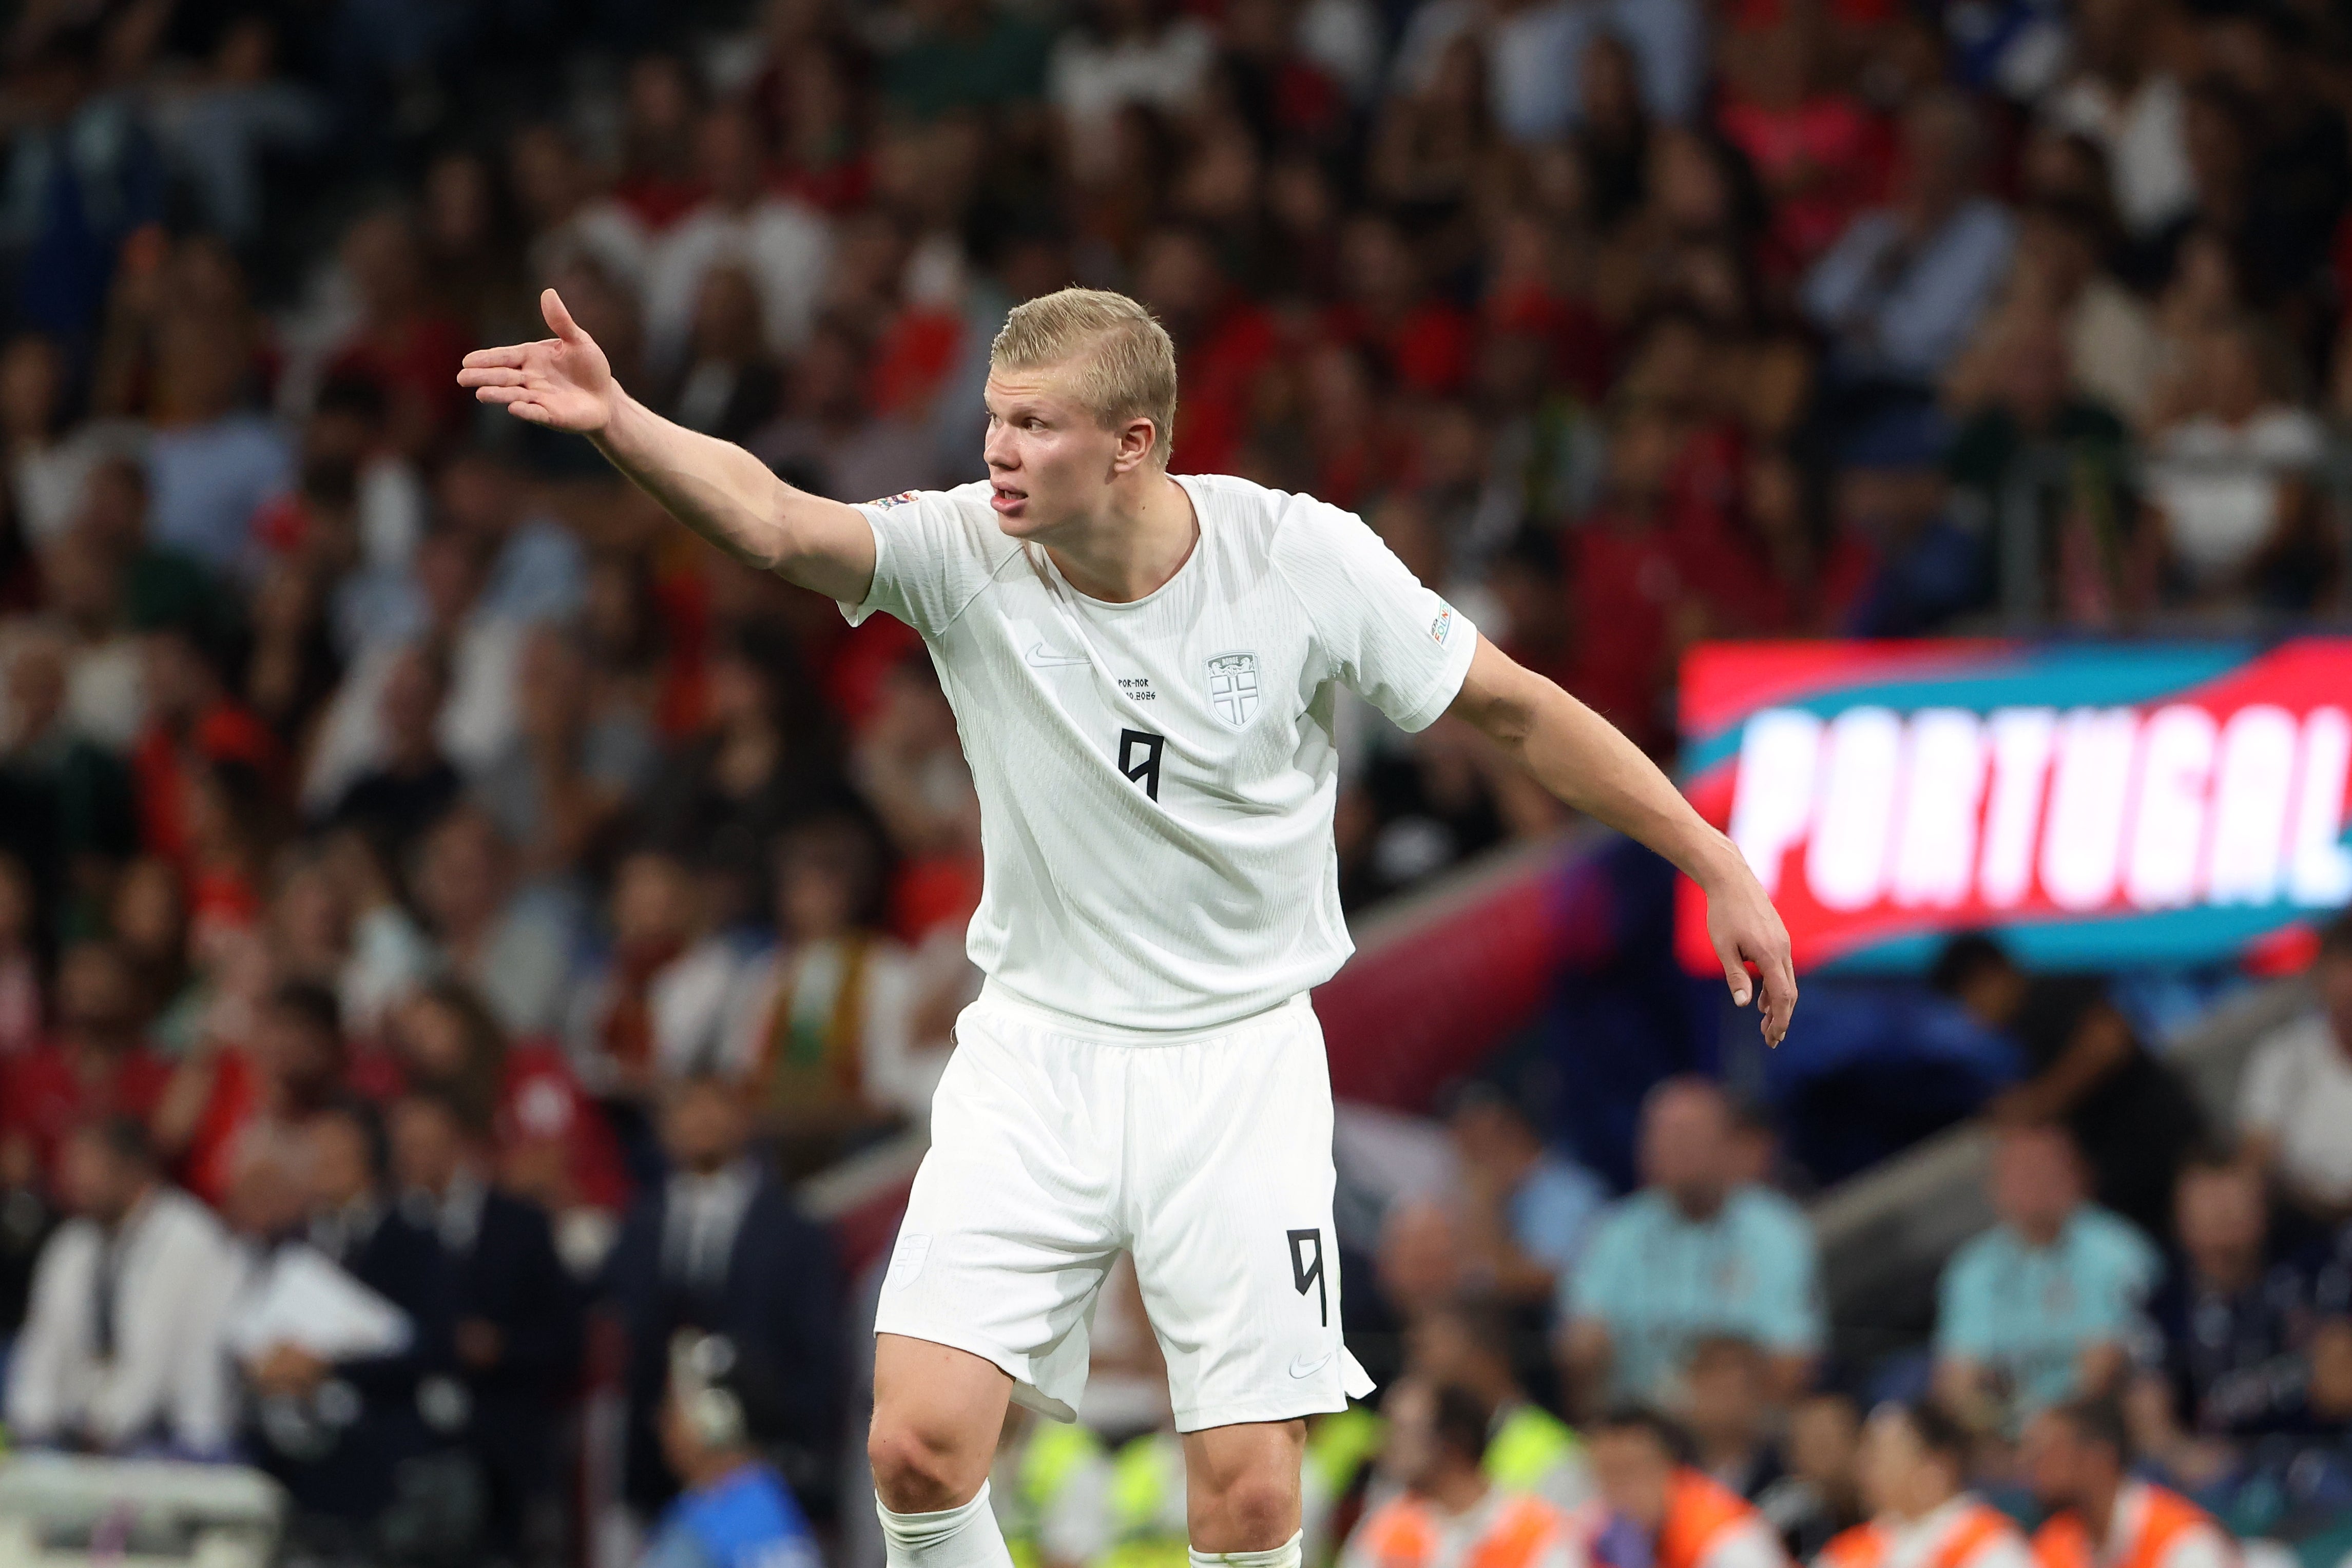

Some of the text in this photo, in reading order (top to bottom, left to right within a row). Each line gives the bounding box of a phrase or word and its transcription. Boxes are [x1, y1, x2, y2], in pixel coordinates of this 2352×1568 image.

[1430, 618, 1438, 636] UEFA
[1435, 602, 1449, 643] FOUND
[1222, 656, 1239, 666] NORGE
[1118, 679, 1149, 688] POR-NOR
[1118, 727, 1165, 804] 9
[1730, 702, 2352, 911] PORTUGAL
[1286, 1228, 1327, 1327] 9
